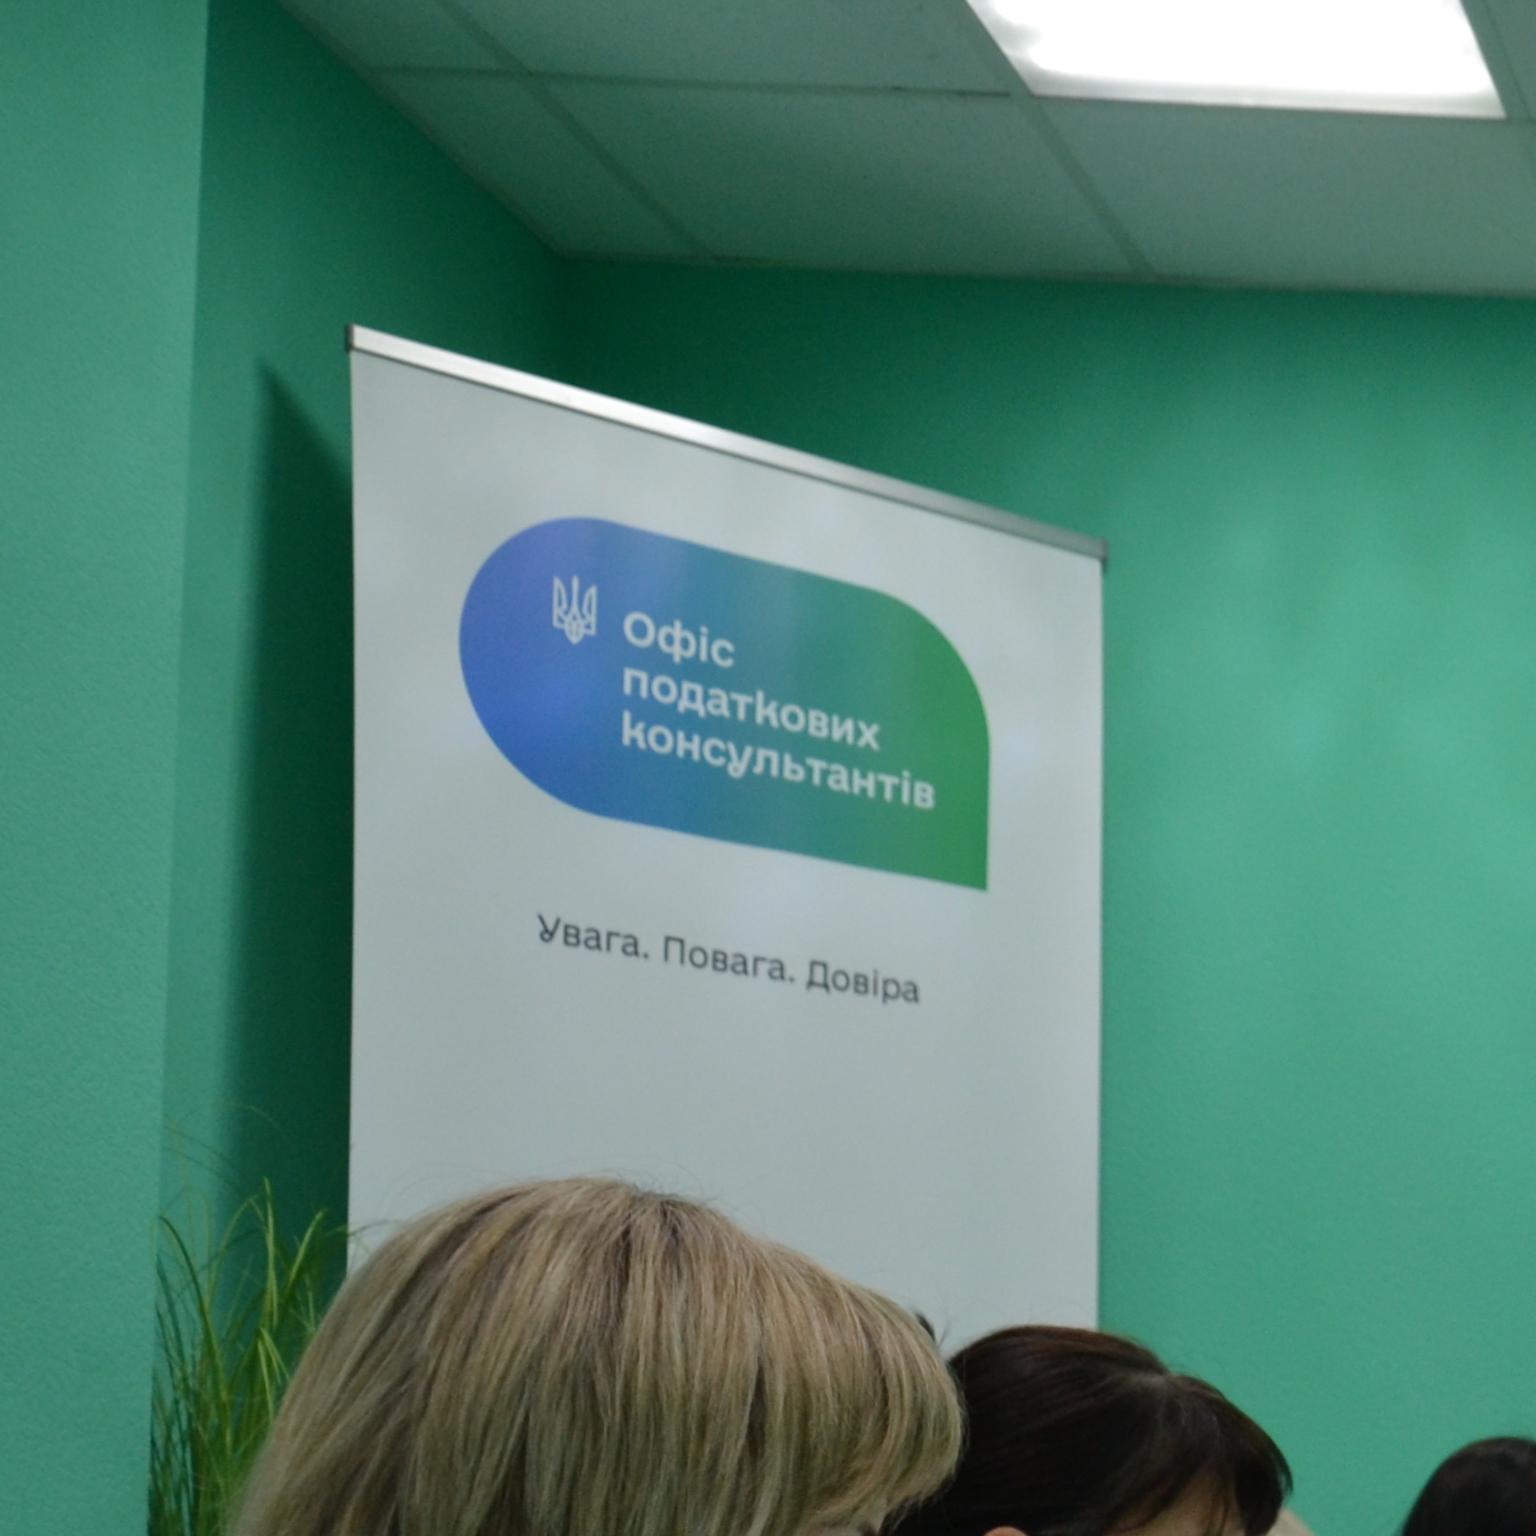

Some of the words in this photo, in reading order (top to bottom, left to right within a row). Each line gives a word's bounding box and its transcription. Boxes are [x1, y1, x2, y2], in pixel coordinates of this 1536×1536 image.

[623, 610, 735, 668] Офіс
[623, 666, 880, 751] податкових
[622, 709, 936, 810] консультантів
[537, 913, 650, 960] Увага.
[663, 935, 796, 983] Повага.
[806, 959, 921, 1005] Довіра
